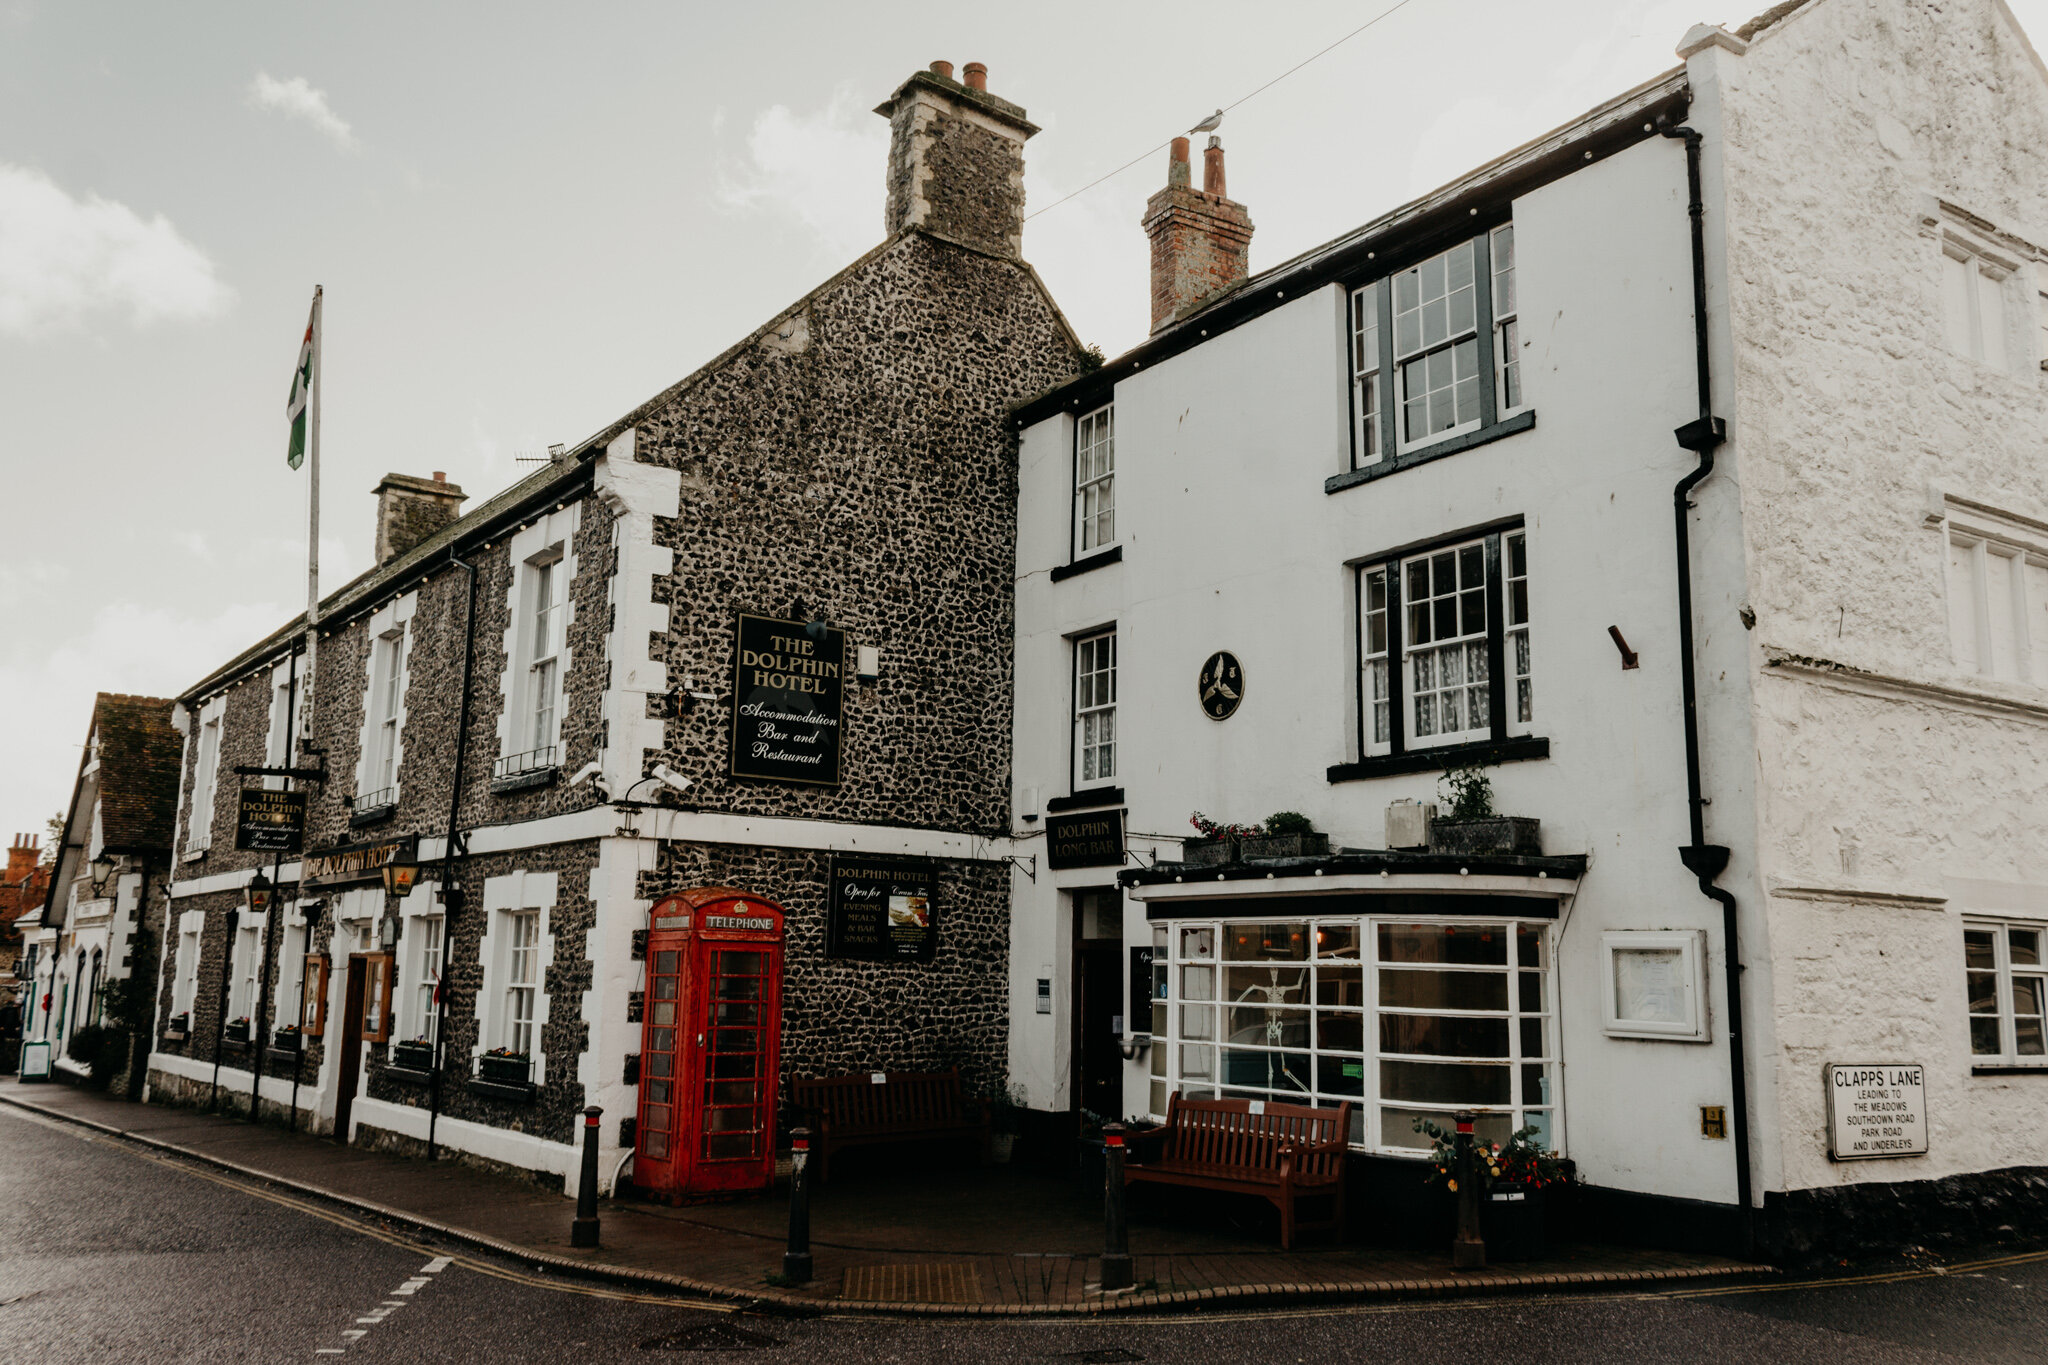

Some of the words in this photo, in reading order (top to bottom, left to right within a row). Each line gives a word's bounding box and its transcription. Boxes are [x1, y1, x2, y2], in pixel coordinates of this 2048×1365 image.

[770, 635, 815, 656] THE
[743, 650, 839, 678] DOLPHIN
[753, 670, 826, 694] HOTEL
[739, 702, 838, 726] Accommodation
[757, 721, 788, 740] Bar
[793, 731, 819, 744] and
[751, 741, 822, 764] Restaurant
[261, 793, 288, 803] THE
[242, 802, 302, 814] DOLPHIN
[249, 811, 293, 823] HOTEL
[241, 822, 300, 832] Accommodation
[1058, 821, 1110, 839] DOLPHIN
[251, 831, 269, 840] Bar
[247, 840, 290, 850] Restaurant
[1055, 842, 1088, 857] LONG
[1090, 840, 1116, 855] BAR
[304, 858, 323, 877] THE
[323, 850, 366, 875] DOLPHIN
[366, 843, 400, 869] HOT
[837, 867, 890, 880] DOLPHIN
[893, 871, 931, 882] HOTEL
[844, 883, 868, 900] Open
[866, 886, 881, 900] for
[843, 903, 881, 912] EVENING
[709, 917, 772, 930] TELEPHONE
[847, 914, 877, 922] MEALS
[857, 925, 875, 933] BAR
[844, 935, 878, 943] SNACKS
[1835, 1071, 1884, 1087] CLAPPS
[1890, 1071, 1921, 1086] LANE
[1857, 1089, 1889, 1099] LEADING
[1892, 1089, 1901, 1099] TO
[1854, 1103, 1868, 1112] THE
[1871, 1101, 1907, 1111] MEADOWS
[1847, 1115, 1893, 1125] SOUTHDOWN
[1896, 1114, 1915, 1123] ROAD
[1861, 1128, 1880, 1137] PARK
[1883, 1127, 1902, 1136] ROAD
[1853, 1141, 1868, 1150] AND
[1872, 1139, 1912, 1150] UNDERLEYS
